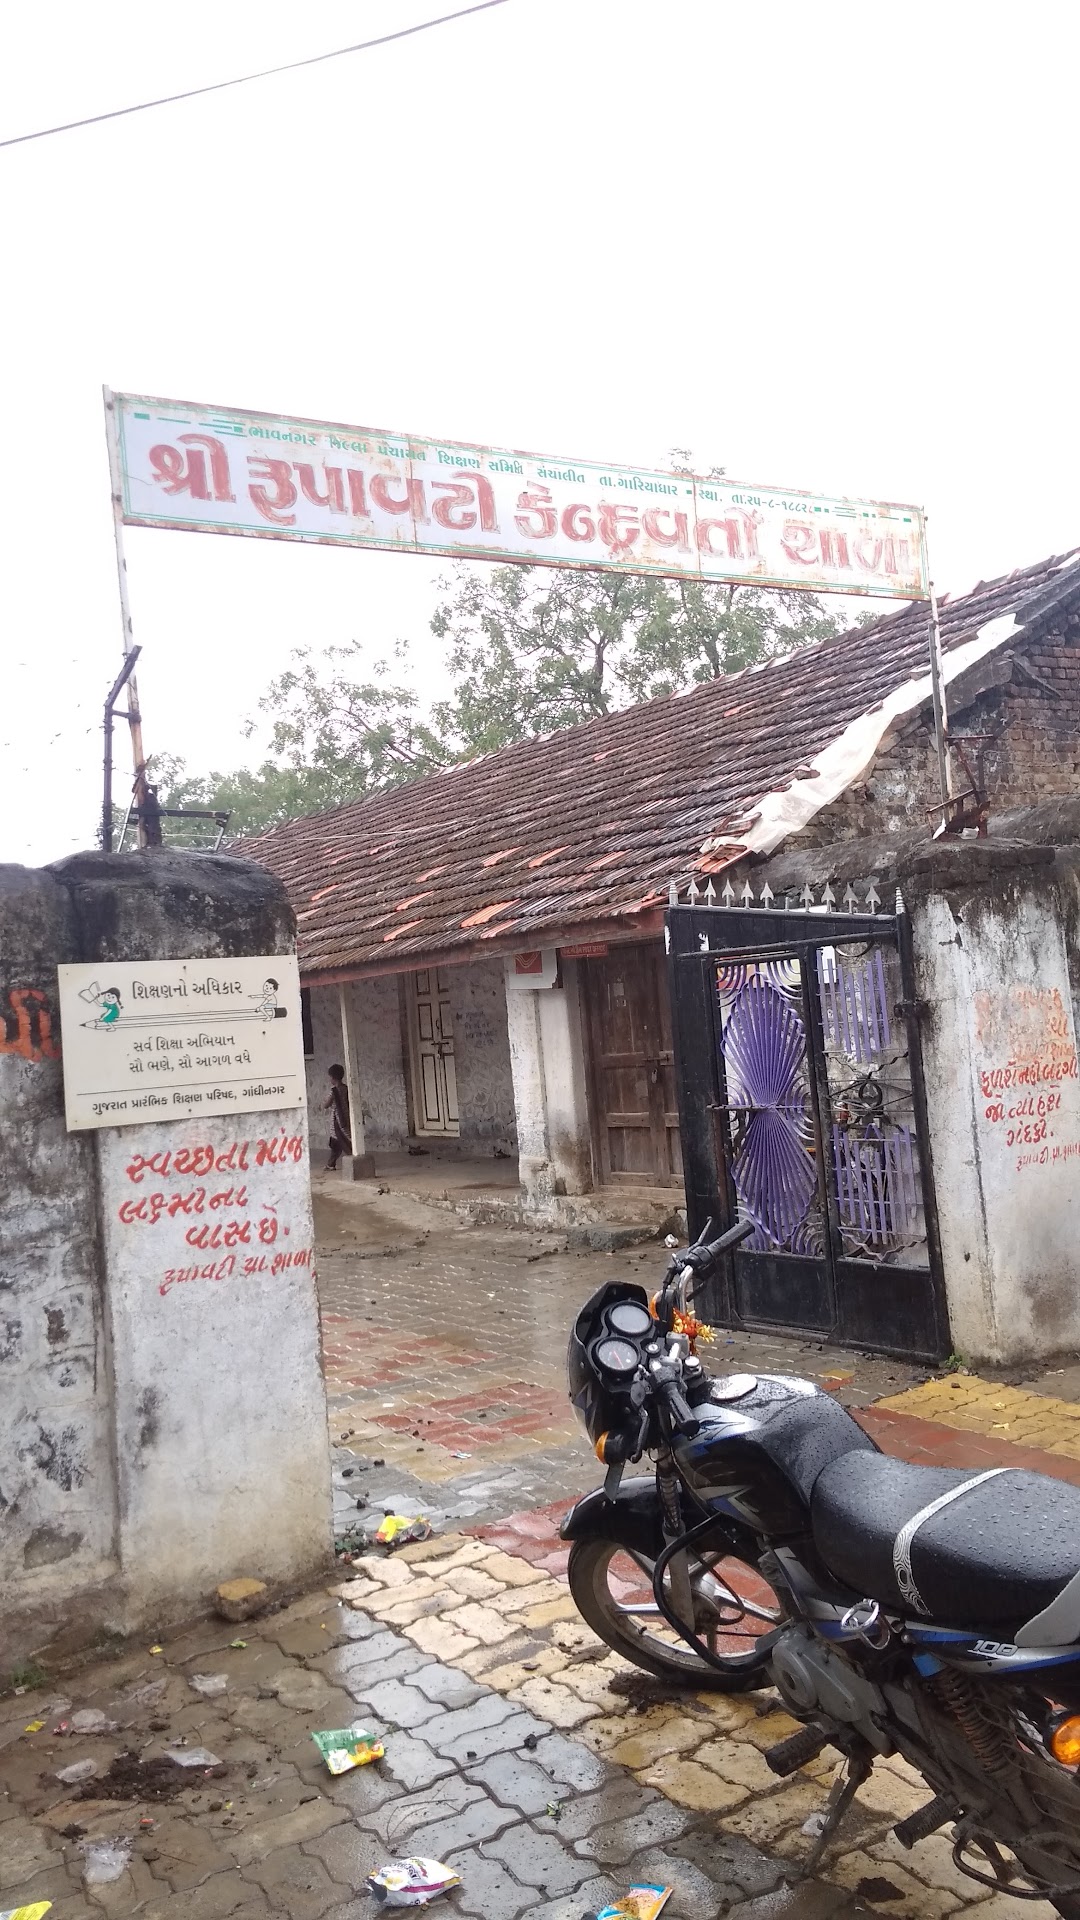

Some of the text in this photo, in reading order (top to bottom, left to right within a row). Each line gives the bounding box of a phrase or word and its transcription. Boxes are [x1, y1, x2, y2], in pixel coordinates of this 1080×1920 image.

[248, 425, 316, 446] ભાવનગર
[437, 450, 480, 469] શિક્ષણ
[537, 466, 585, 484] સંચાલીત
[149, 433, 236, 503] શ્રી
[247, 456, 501, 534] રૂપાવટી
[780, 523, 909, 574] શાળા
[132, 977, 243, 999] શિક્ષણનો અધિકાર
[133, 1033, 235, 1052] સર્વ શિક્ષા અભિયાન
[129, 1049, 251, 1073] સૌ ભણે, સૌ આગળ વધે
[92, 1084, 285, 1115] ગુજરાત પ્રારંભિક શિક્ષણ પરિષદ, ગાંધીનગર
[125, 1141, 250, 1183] સ્વચ્છતા
[972, 1639, 1018, 1657] 100
